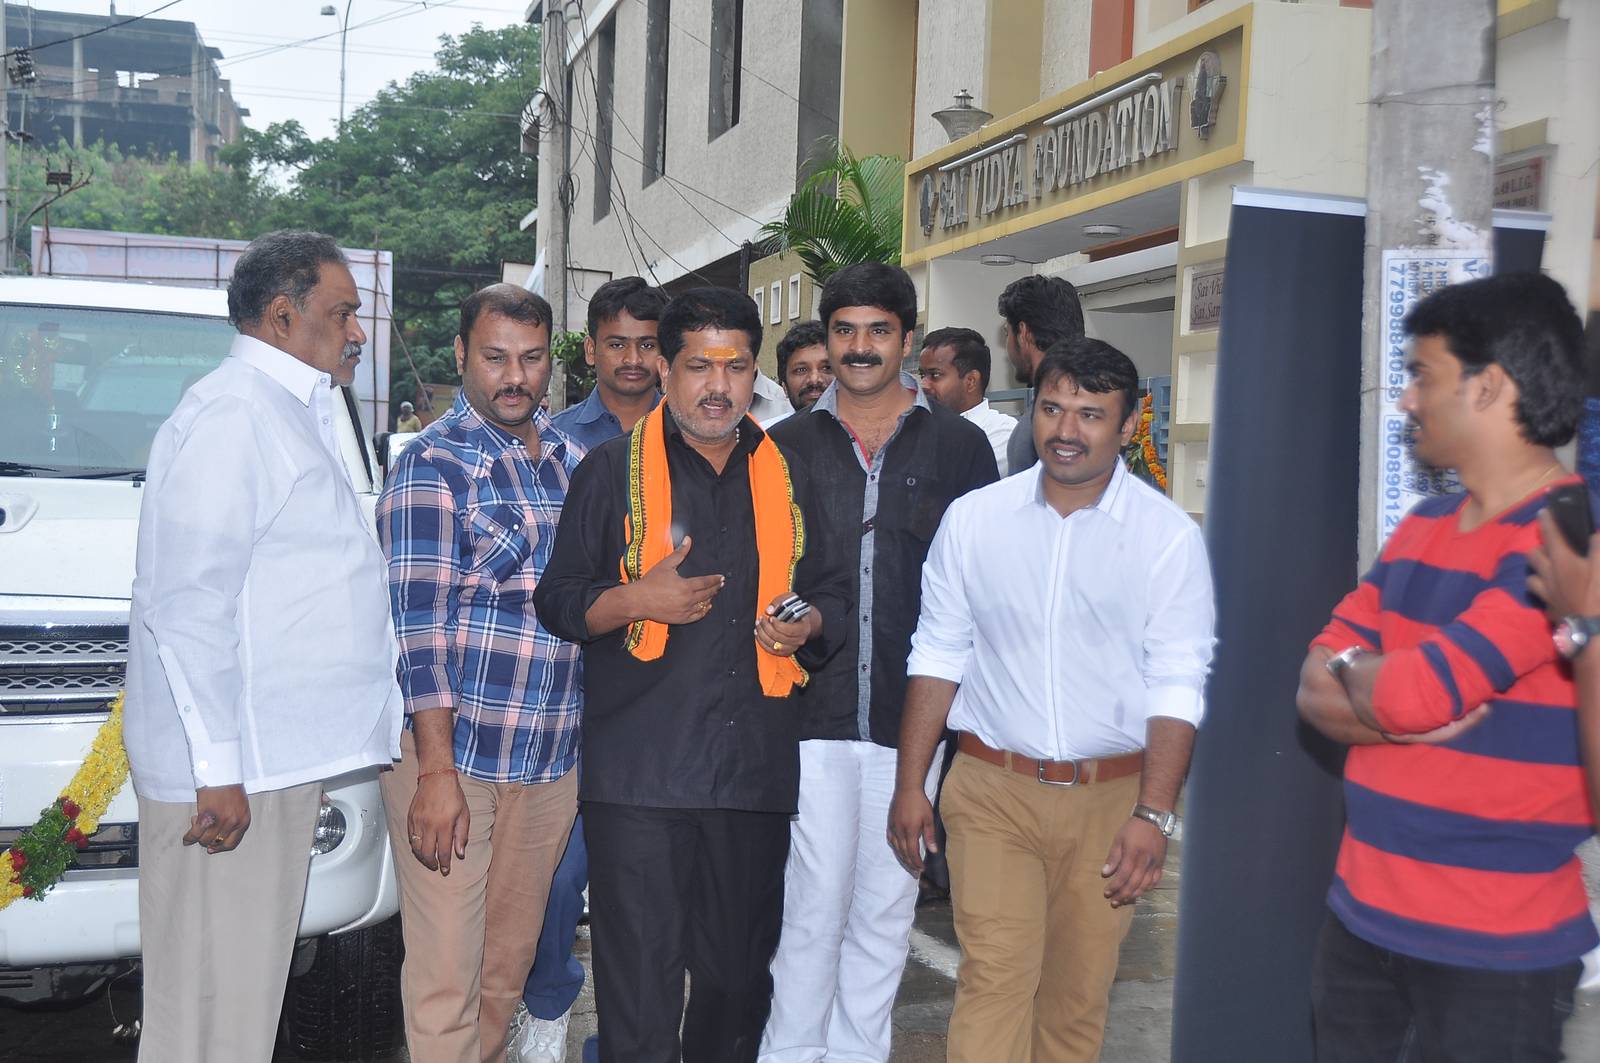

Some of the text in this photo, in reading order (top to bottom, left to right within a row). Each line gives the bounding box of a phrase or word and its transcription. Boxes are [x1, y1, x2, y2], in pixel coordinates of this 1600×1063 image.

[940, 77, 1184, 229] SAI VIDYA FOUNDATION
